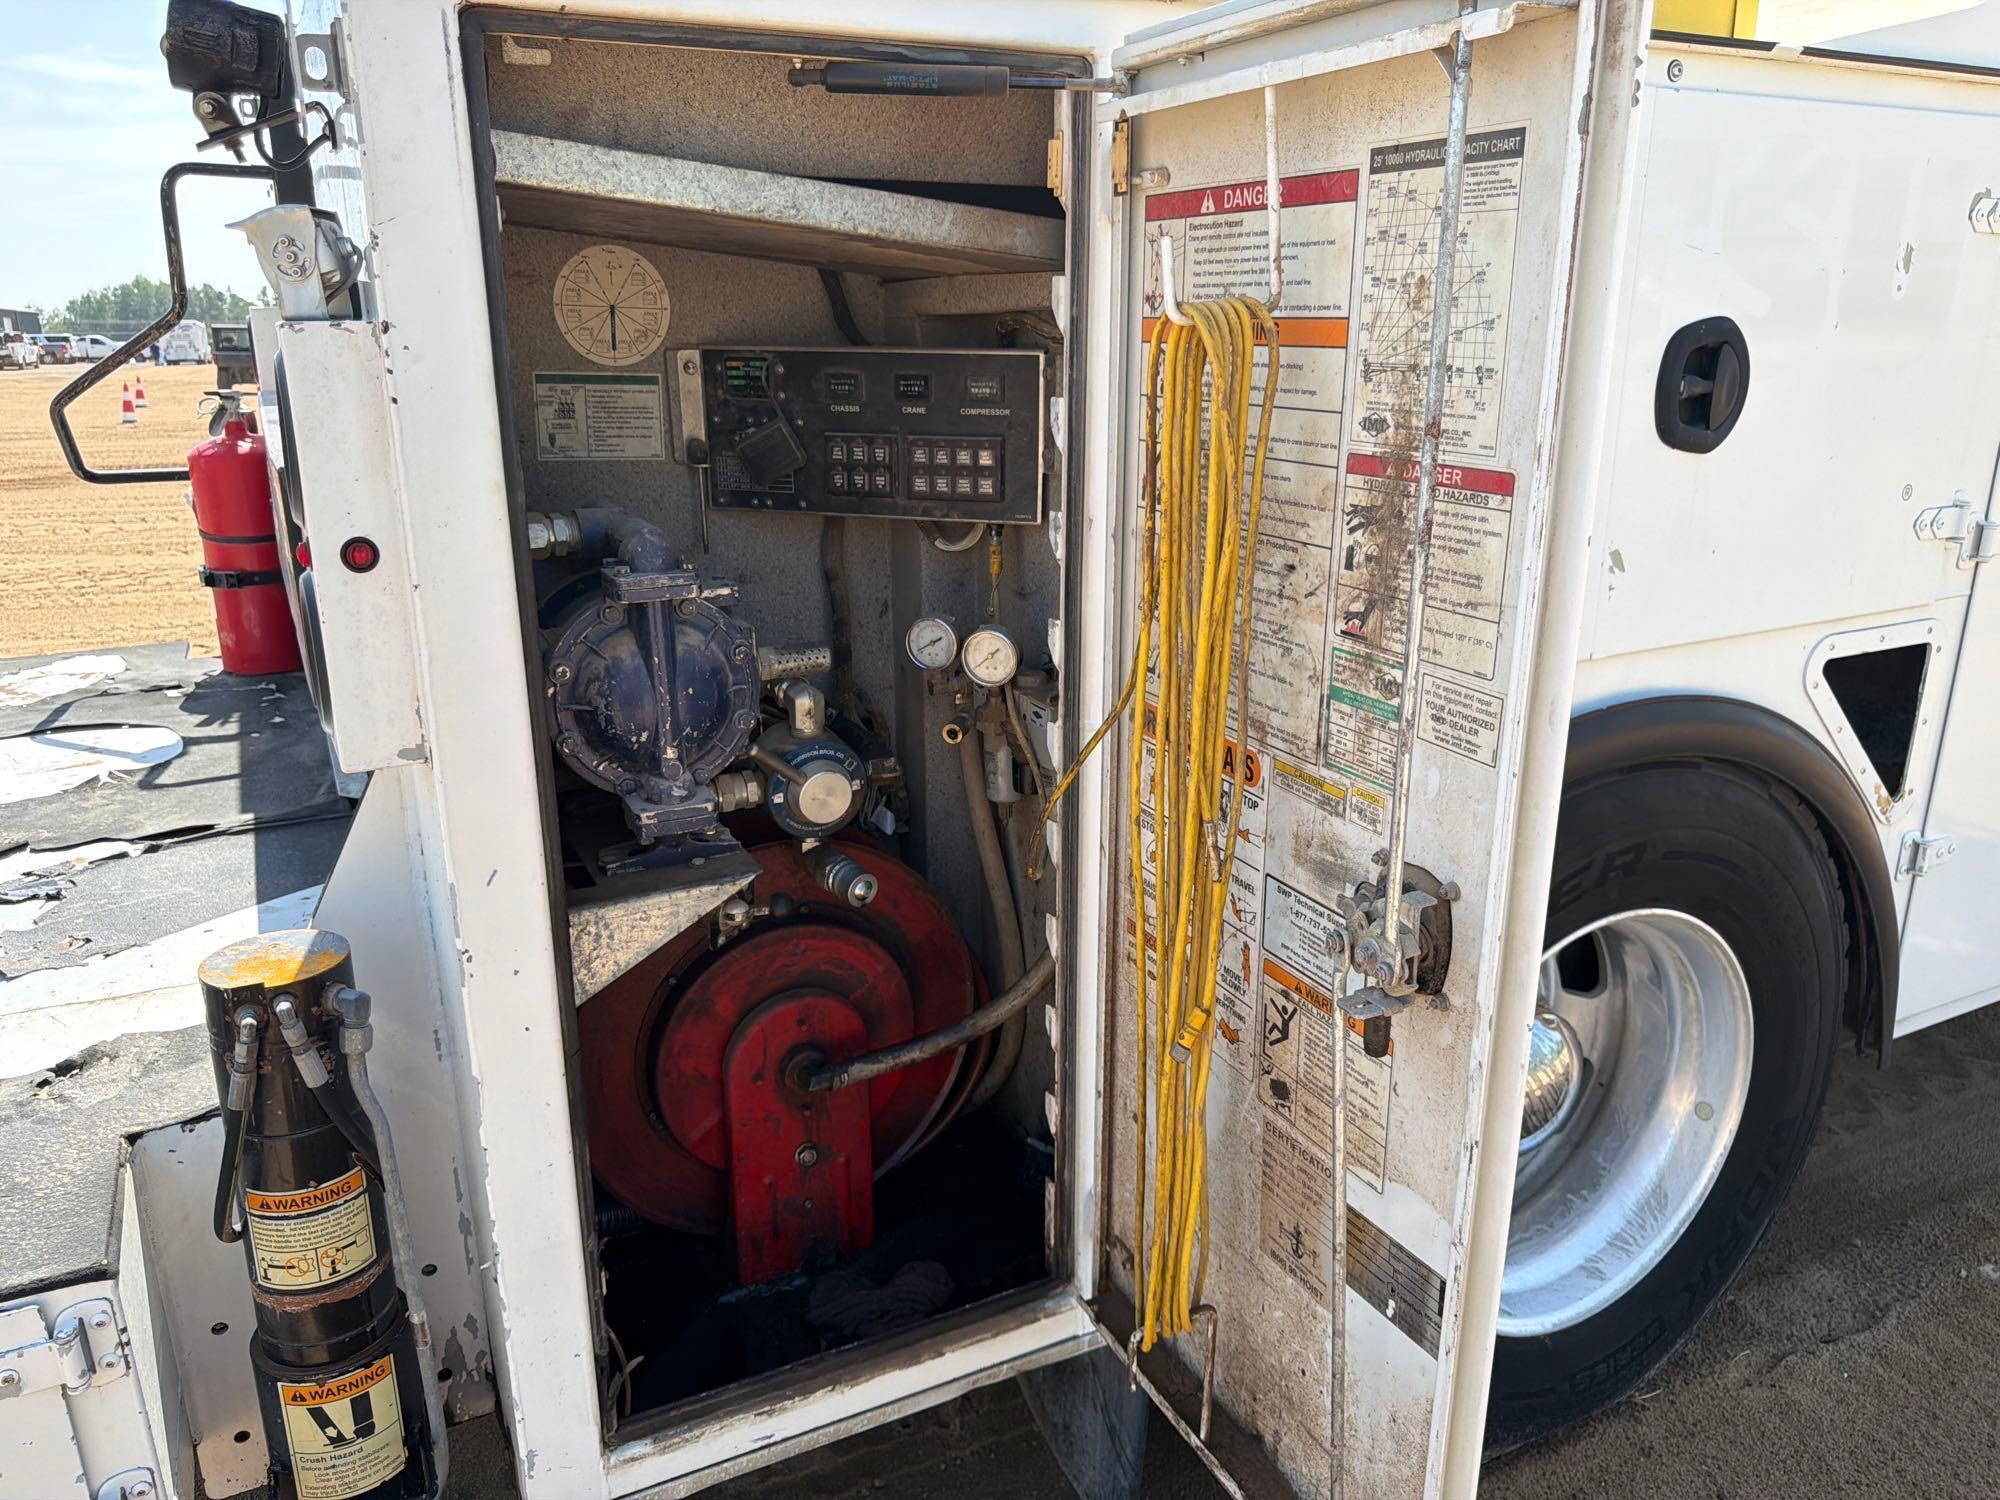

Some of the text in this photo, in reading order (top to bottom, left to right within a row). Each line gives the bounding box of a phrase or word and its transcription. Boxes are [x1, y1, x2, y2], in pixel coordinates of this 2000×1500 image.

[1384, 152, 1404, 166] 10000
[1464, 142, 1490, 156] PACITY
[1490, 137, 1521, 152] CHART
[1188, 218, 1244, 231] Electrocution Hazard
[1299, 241, 1320, 249] equipment
[1317, 304, 1332, 312] power
[1332, 303, 1343, 311] line.
[960, 408, 1010, 416] COMPRESSOR
[1403, 462, 1463, 486] DAGER
[1443, 489, 1490, 506] HAZARDS
[1460, 513, 1477, 521] pierce
[1435, 521, 1452, 529] before
[1452, 525, 1473, 534] working
[1482, 529, 1503, 538] system.
[1265, 538, 1299, 554] Procedures
[1435, 629, 1454, 639] exceed
[1455, 633, 1467, 641] 120°
[1432, 681, 1493, 708] For service and repair
[1424, 689, 1432, 697] on
[1432, 691, 1442, 700] this
[1475, 706, 1498, 719] contact:
[1425, 699, 1496, 732] YOUR AUTHORIZED
[1449, 719, 1479, 737] DEALER
[1434, 735, 1478, 756] www.imt.com
[790, 750, 818, 766] MORRISON
[1275, 770, 1289, 780] AVOID
[1290, 776, 1318, 796] EQUIPMENT
[1293, 769, 1325, 788] CAUTION!
[1280, 779, 1313, 799] Check level
[1356, 788, 1380, 804] CAUTION
[1242, 795, 1260, 811] TOP
[1143, 877, 1157, 893] RAIS
[1231, 874, 1256, 896] TRAVEL
[1276, 885, 1292, 898] SWP
[1293, 895, 1326, 919] Technical
[1223, 966, 1242, 984] MOVE
[1220, 974, 1247, 998] SLOWLY
[1216, 998, 1246, 1025] VERYTHING
[1265, 1121, 1332, 1179] CERTIFICATIO
[273, 1181, 352, 1211] WARNING
[276, 1230, 297, 1239] beyond
[320, 1225, 330, 1234] pin
[311, 1220, 331, 1230] extend
[301, 1235, 312, 1243] the
[313, 1229, 338, 1241] stabilizer
[309, 1239, 323, 1247] from
[324, 1234, 342, 1243] falling
[309, 1364, 385, 1400] WARNING
[299, 1446, 364, 1464] Crush Hazard
[358, 1443, 390, 1461] stabilizers
[331, 1466, 356, 1476] around
[334, 1473, 350, 1481] area
[304, 1483, 337, 1491] Extending
